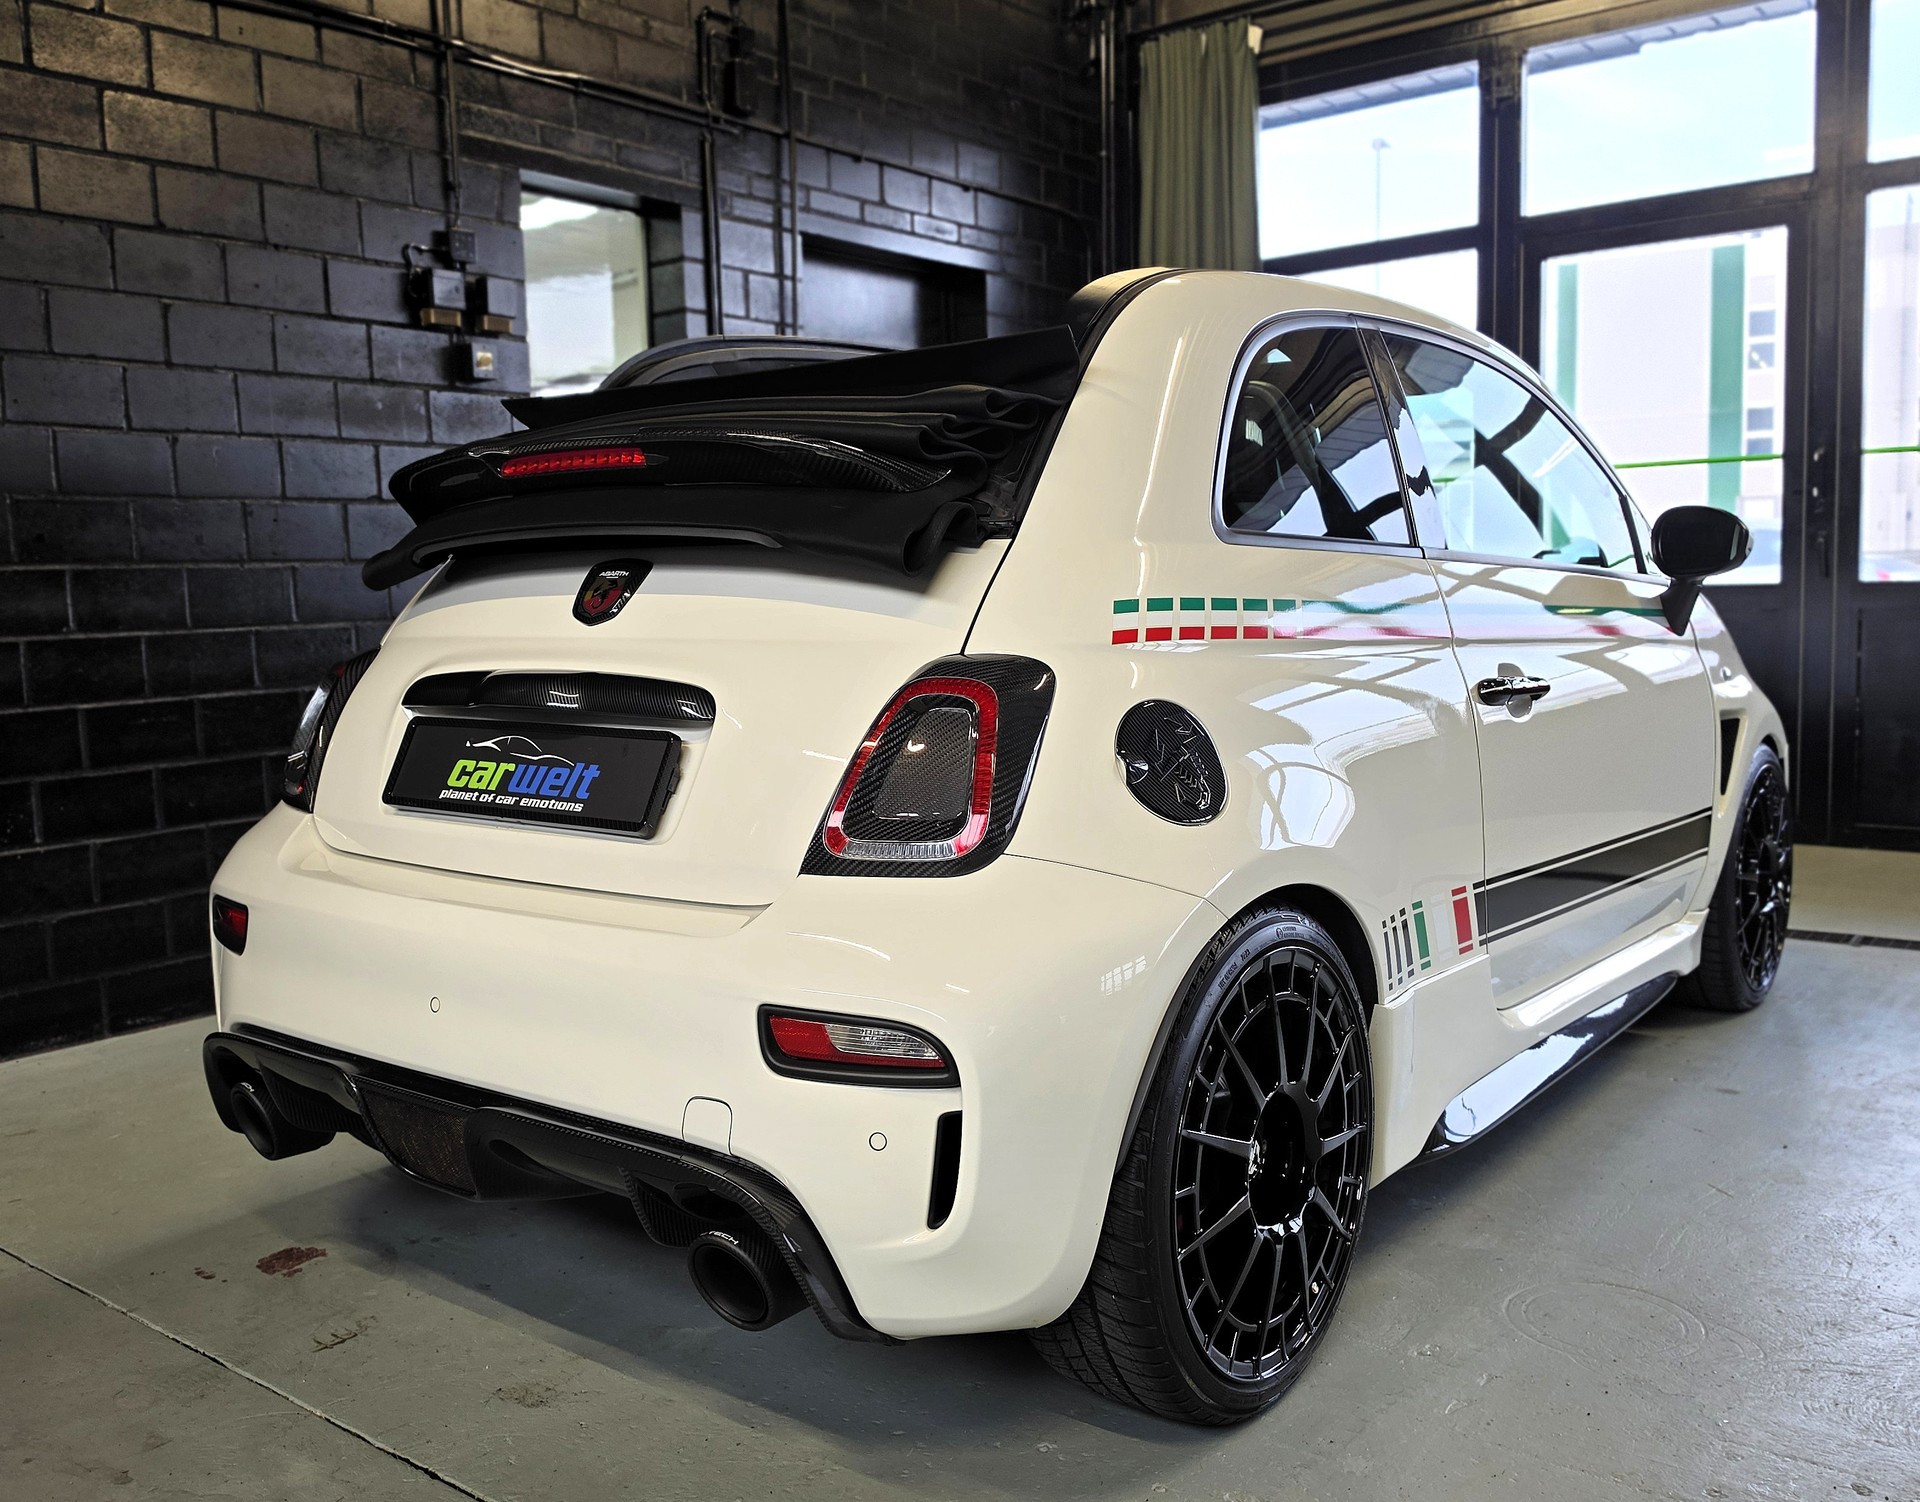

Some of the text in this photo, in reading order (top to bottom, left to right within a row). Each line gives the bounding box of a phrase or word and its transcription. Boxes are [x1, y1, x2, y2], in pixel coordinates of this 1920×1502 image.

[447, 759, 600, 799] carwelt
[439, 789, 584, 812] planet of car emotions
